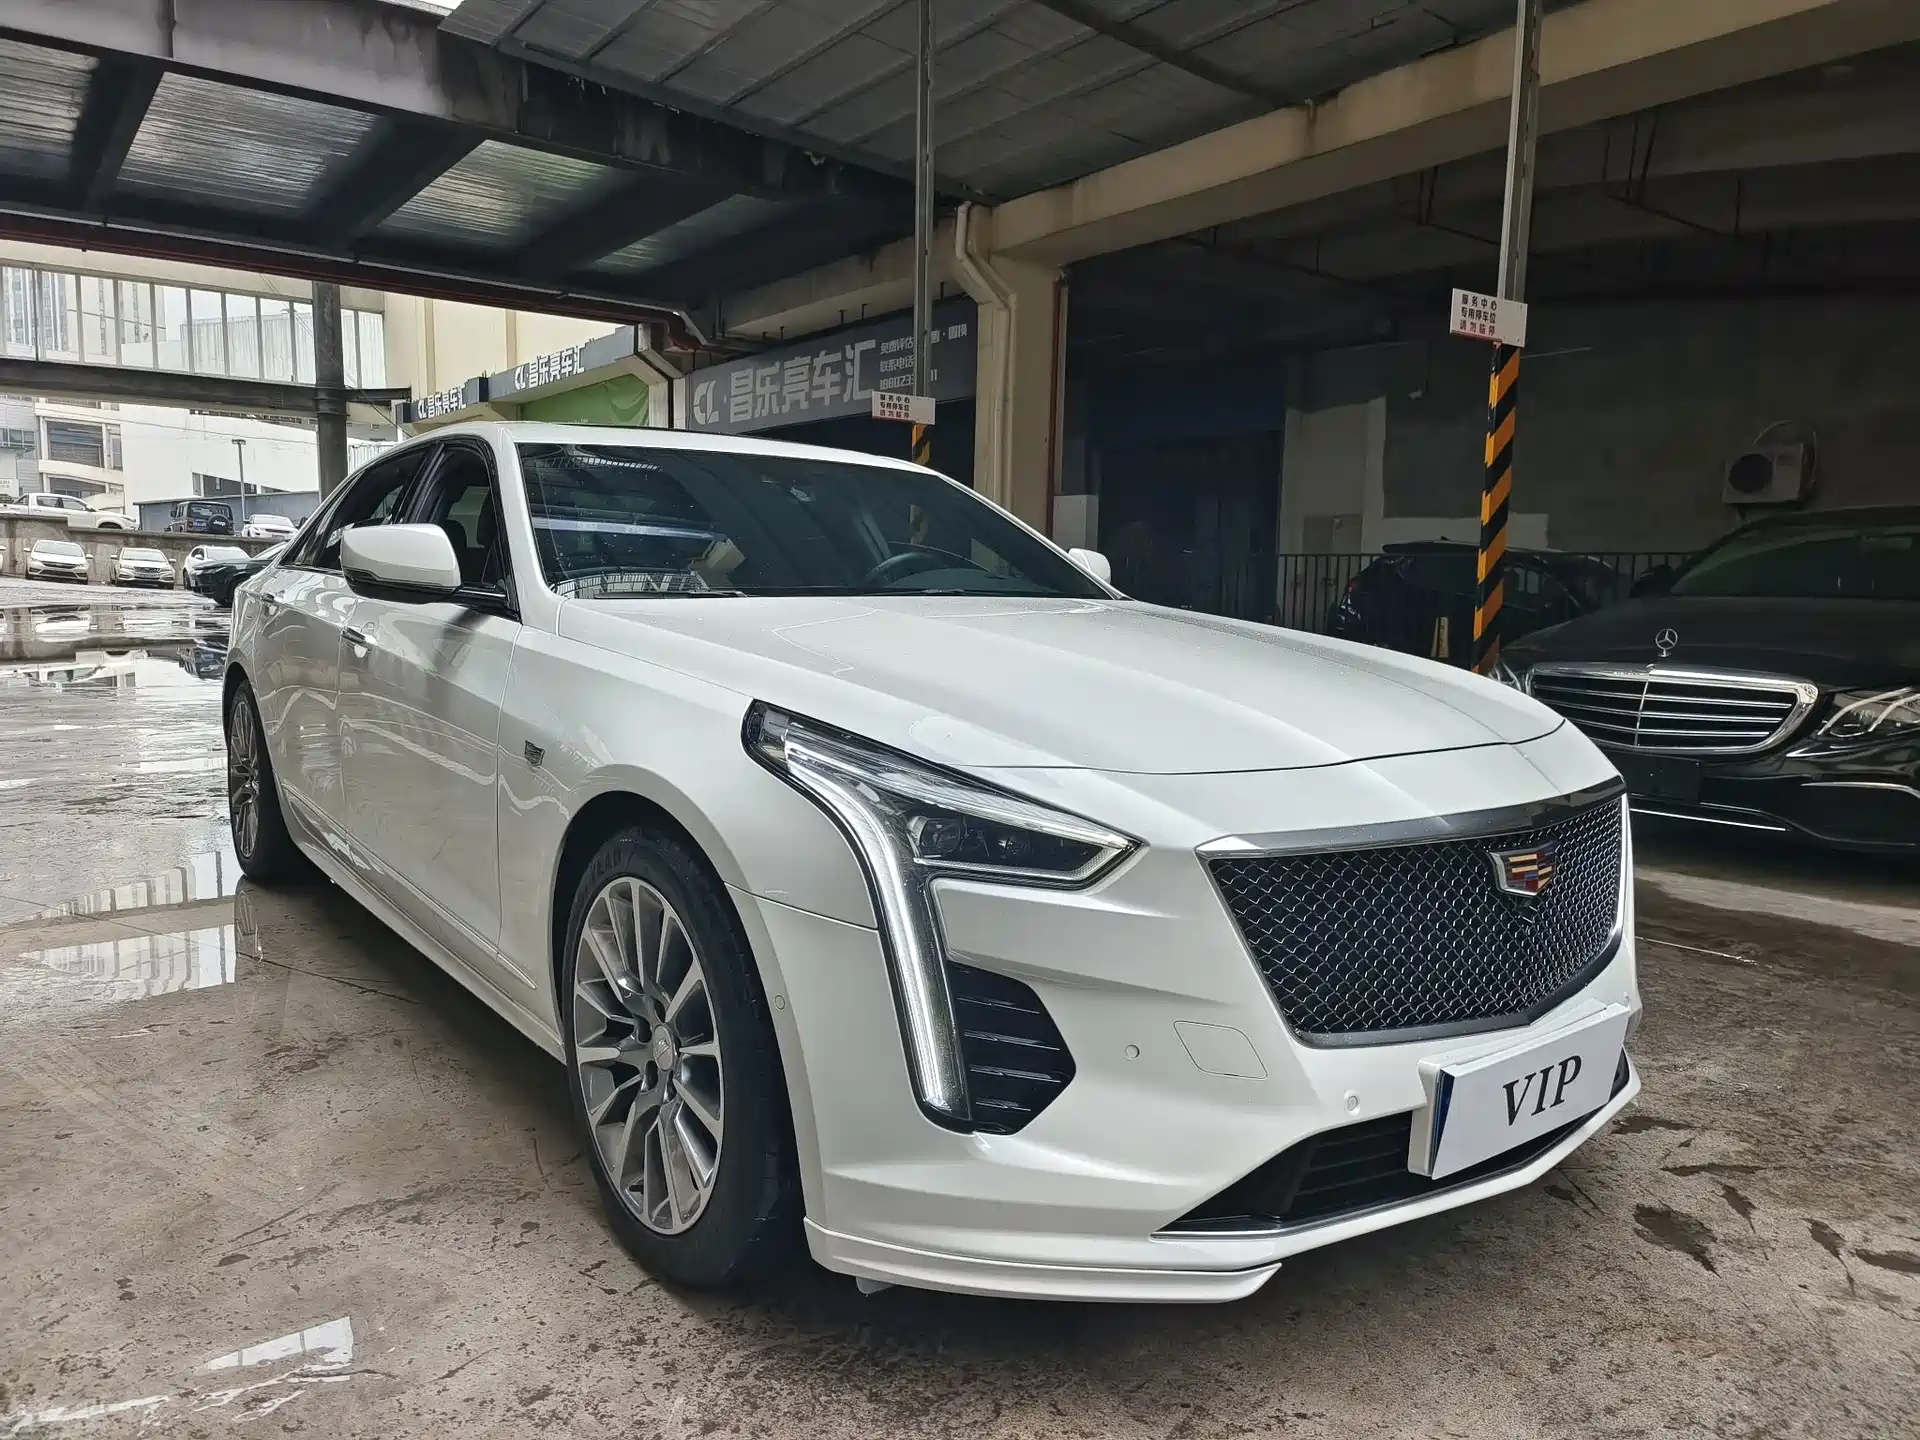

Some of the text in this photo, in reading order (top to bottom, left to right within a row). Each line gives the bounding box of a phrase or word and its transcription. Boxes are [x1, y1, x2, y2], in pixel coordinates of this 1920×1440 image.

[1462, 293, 1498, 311] 服务中心
[1461, 307, 1497, 324] 专用停车位
[1502, 1055, 1582, 1126] VIP
